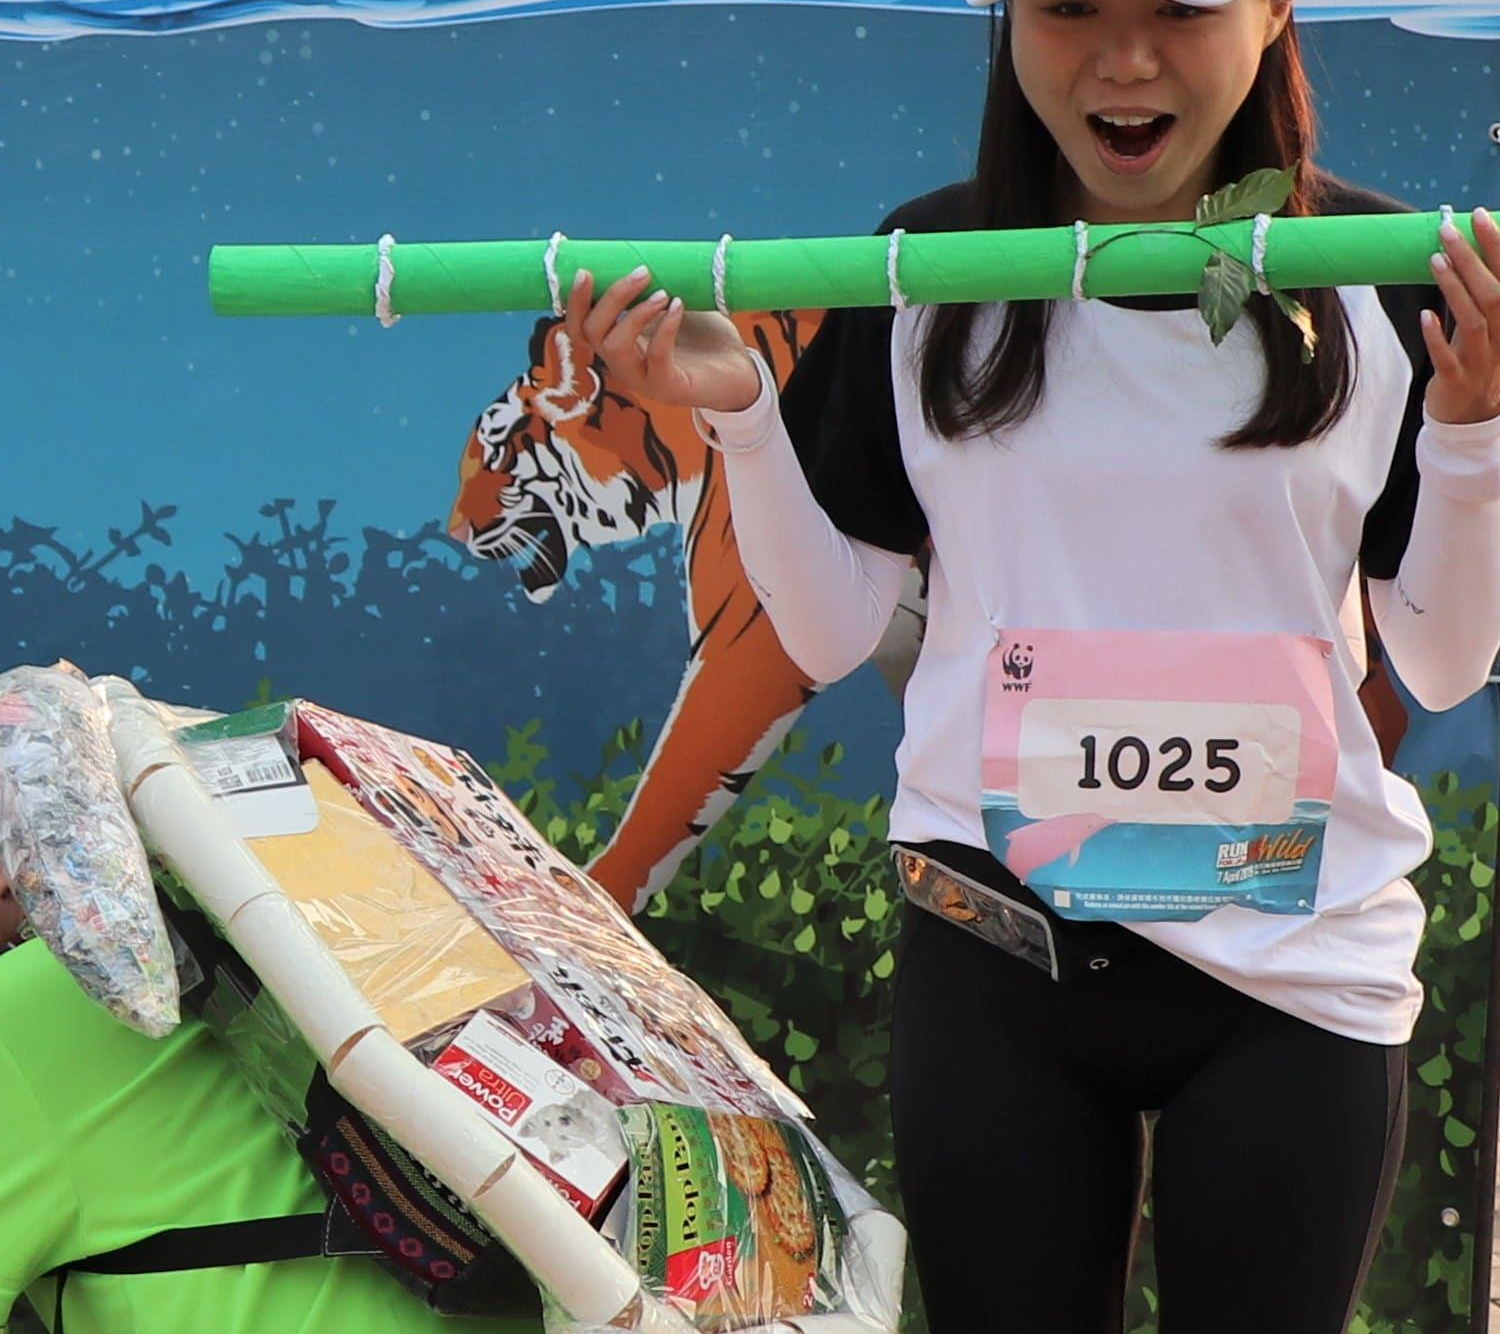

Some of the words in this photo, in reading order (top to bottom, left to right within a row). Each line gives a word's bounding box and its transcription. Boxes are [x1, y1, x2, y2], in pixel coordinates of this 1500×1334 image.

[1001, 682, 1032, 693] WWF
[1077, 735, 1242, 794] 1025
[1219, 841, 1248, 858] RUN
[1257, 828, 1316, 861] Wild
[446, 1063, 518, 1123] Power
[478, 1067, 527, 1111] Ultra
[724, 1240, 733, 1286] Garden
